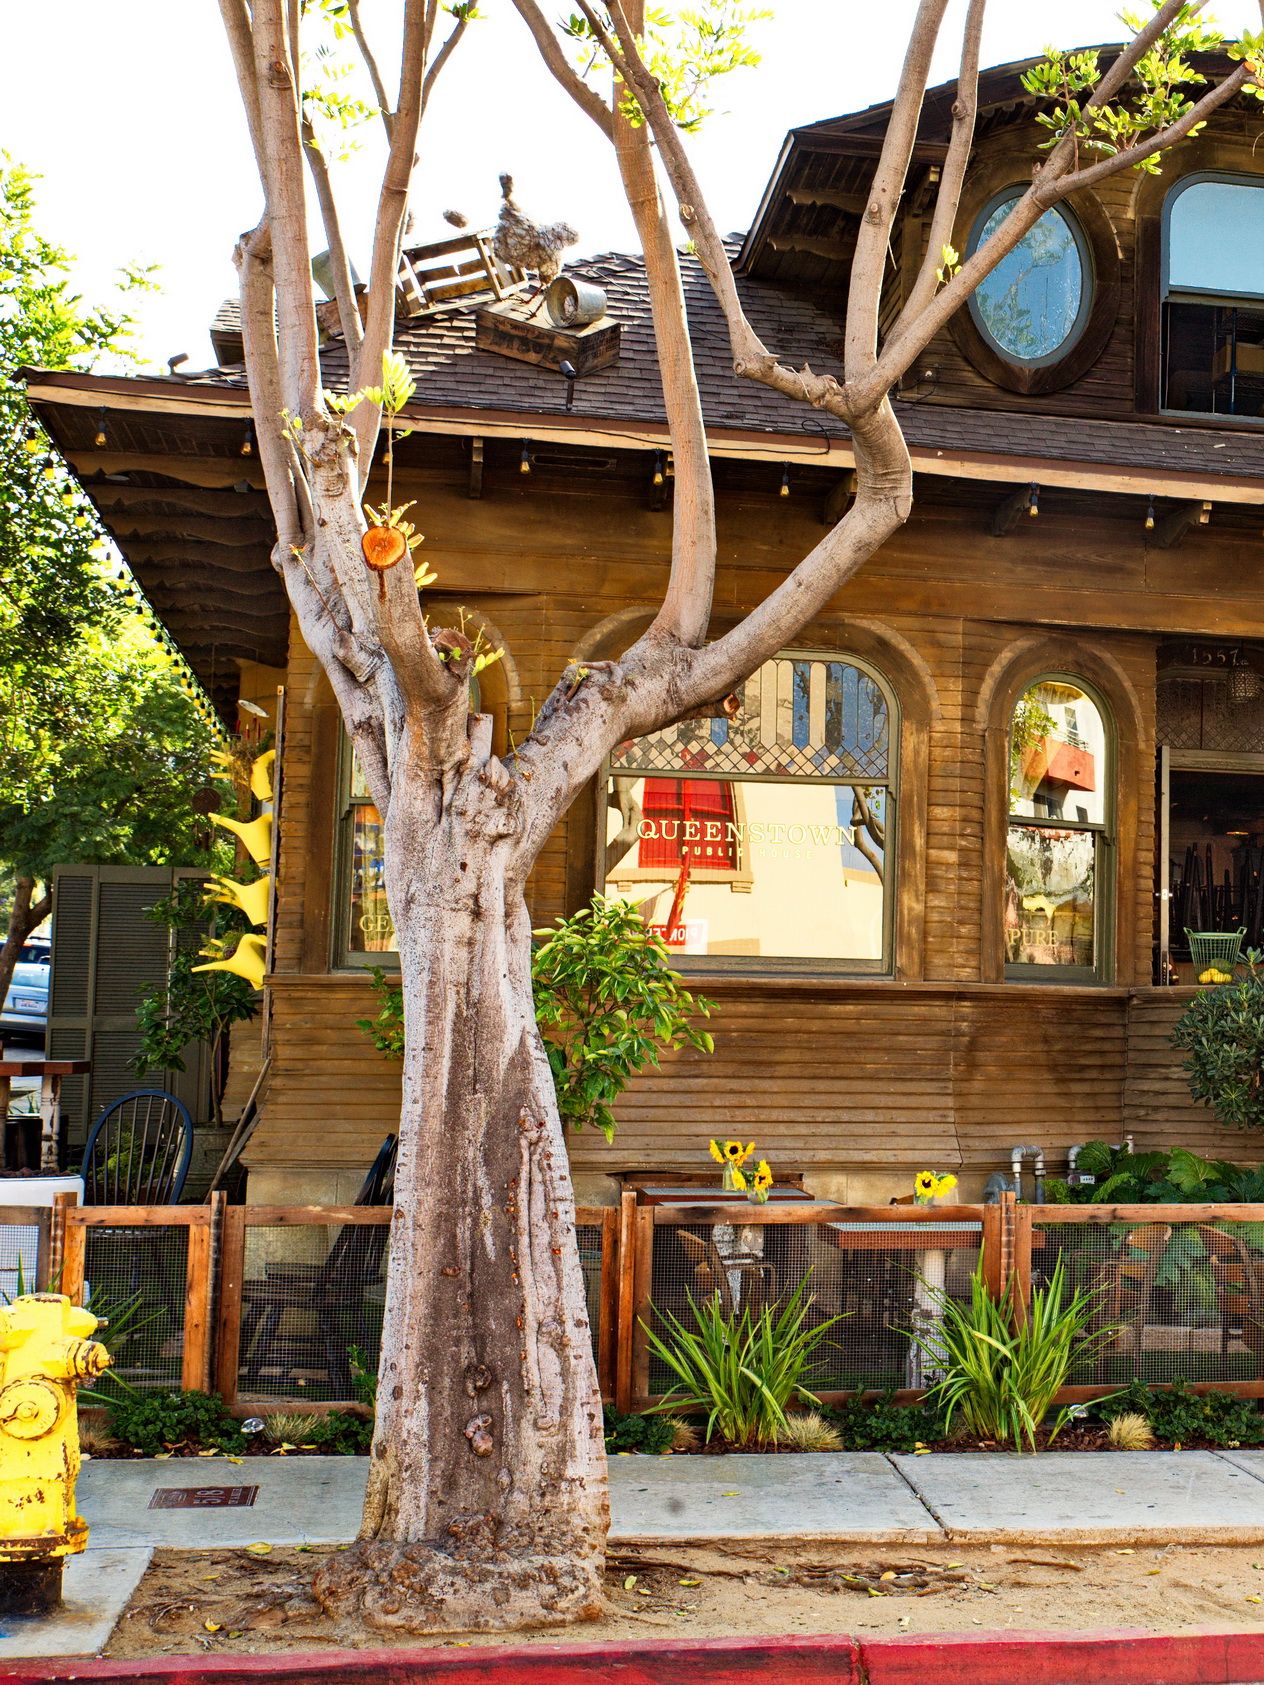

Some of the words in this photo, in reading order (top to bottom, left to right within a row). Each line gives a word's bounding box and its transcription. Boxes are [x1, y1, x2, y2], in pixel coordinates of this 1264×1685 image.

[636, 818, 858, 847] QUEENSTOWN
[681, 846, 744, 857] PUBLIC
[359, 914, 395, 932] GE
[1008, 928, 1059, 947] PURE
